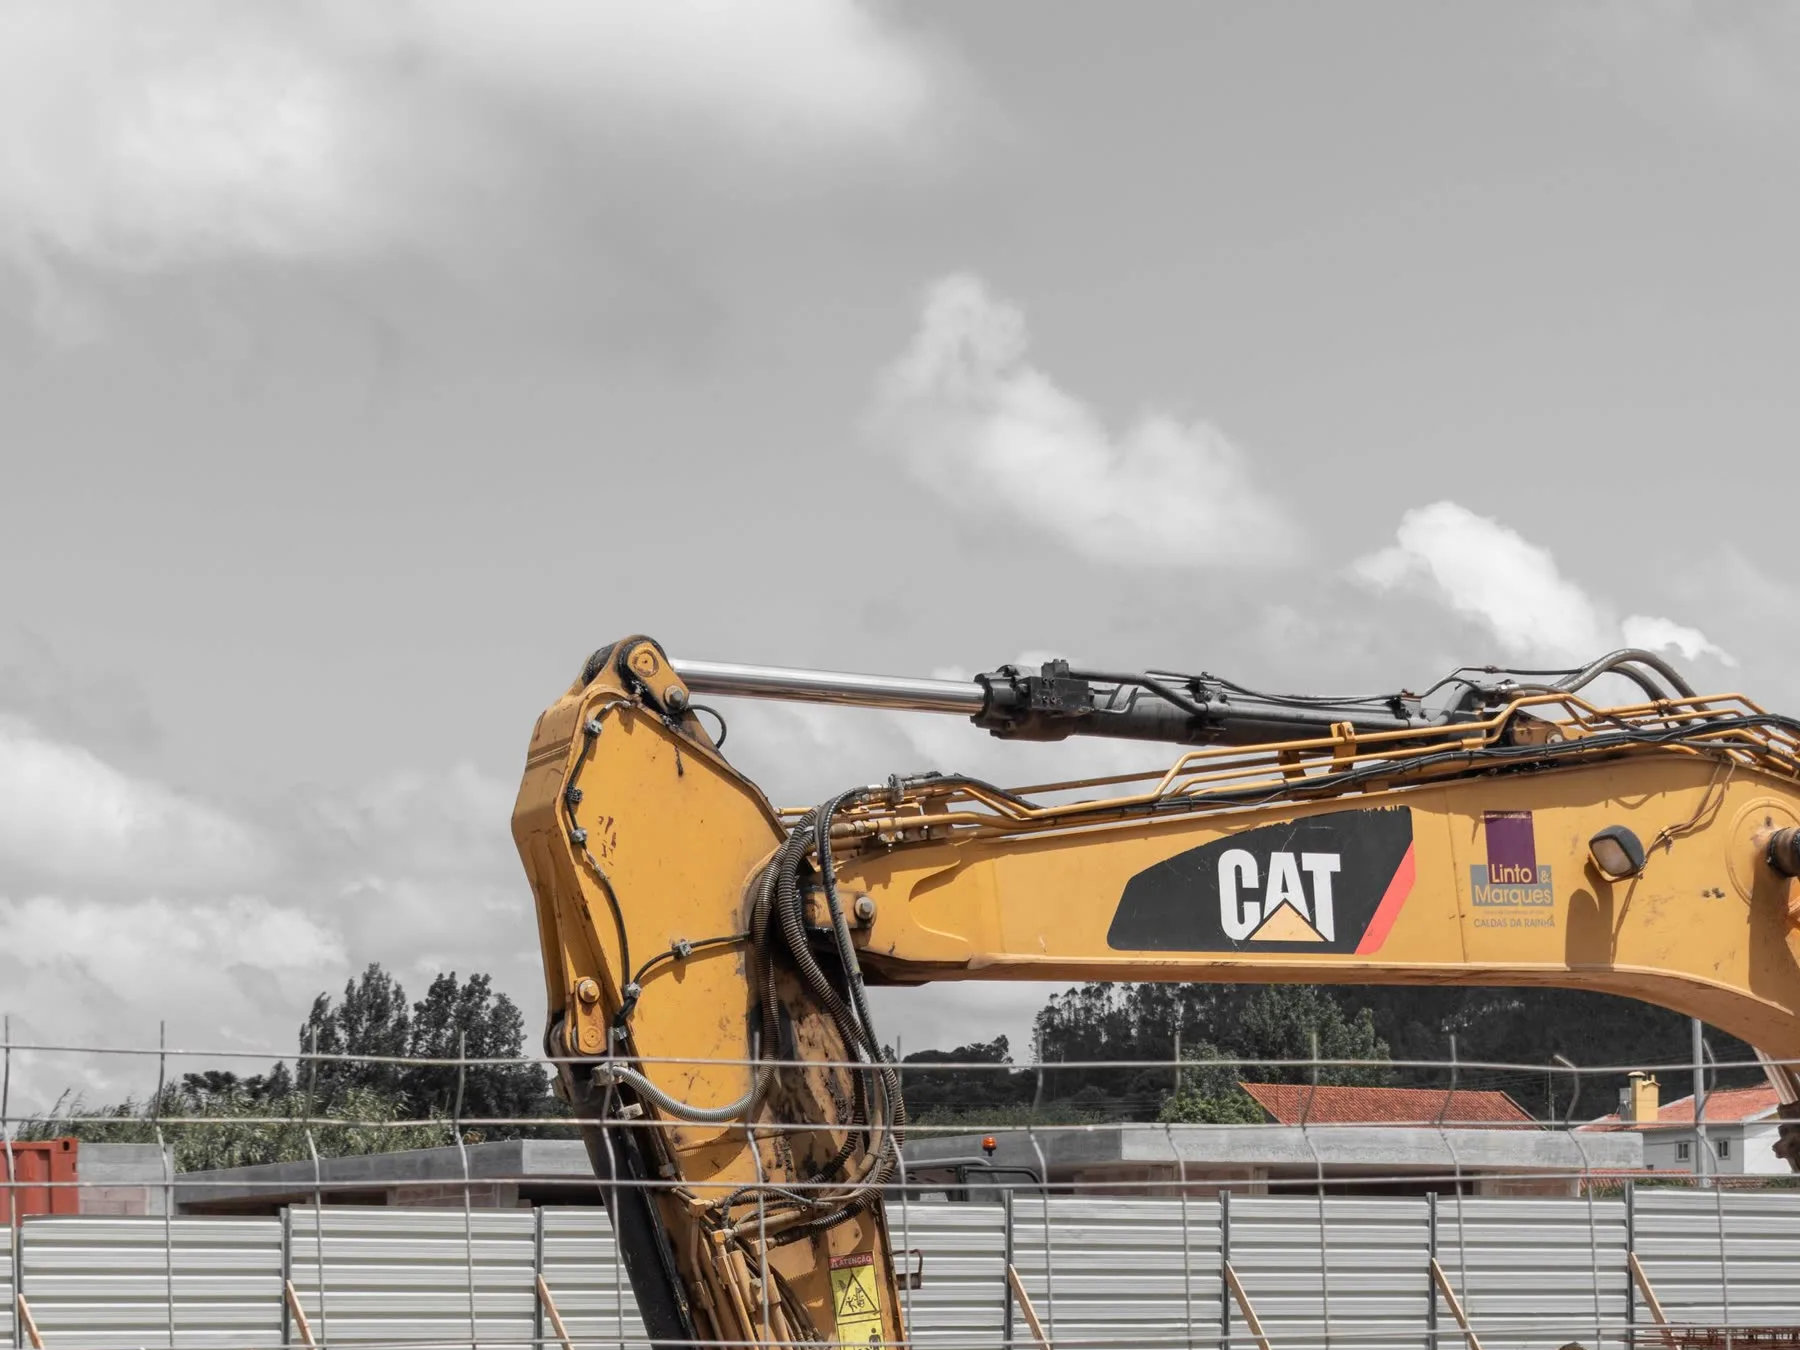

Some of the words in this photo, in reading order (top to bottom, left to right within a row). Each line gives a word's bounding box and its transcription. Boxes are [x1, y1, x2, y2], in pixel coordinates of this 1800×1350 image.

[1491, 864, 1533, 883] Linto
[1540, 870, 1552, 884] &
[1218, 849, 1341, 942] CAT
[1474, 885, 1552, 907] Marques
[1473, 918, 1508, 928] CALDAS
[1509, 918, 1523, 928] DA
[838, 1255, 871, 1265] ATENÇÃO
